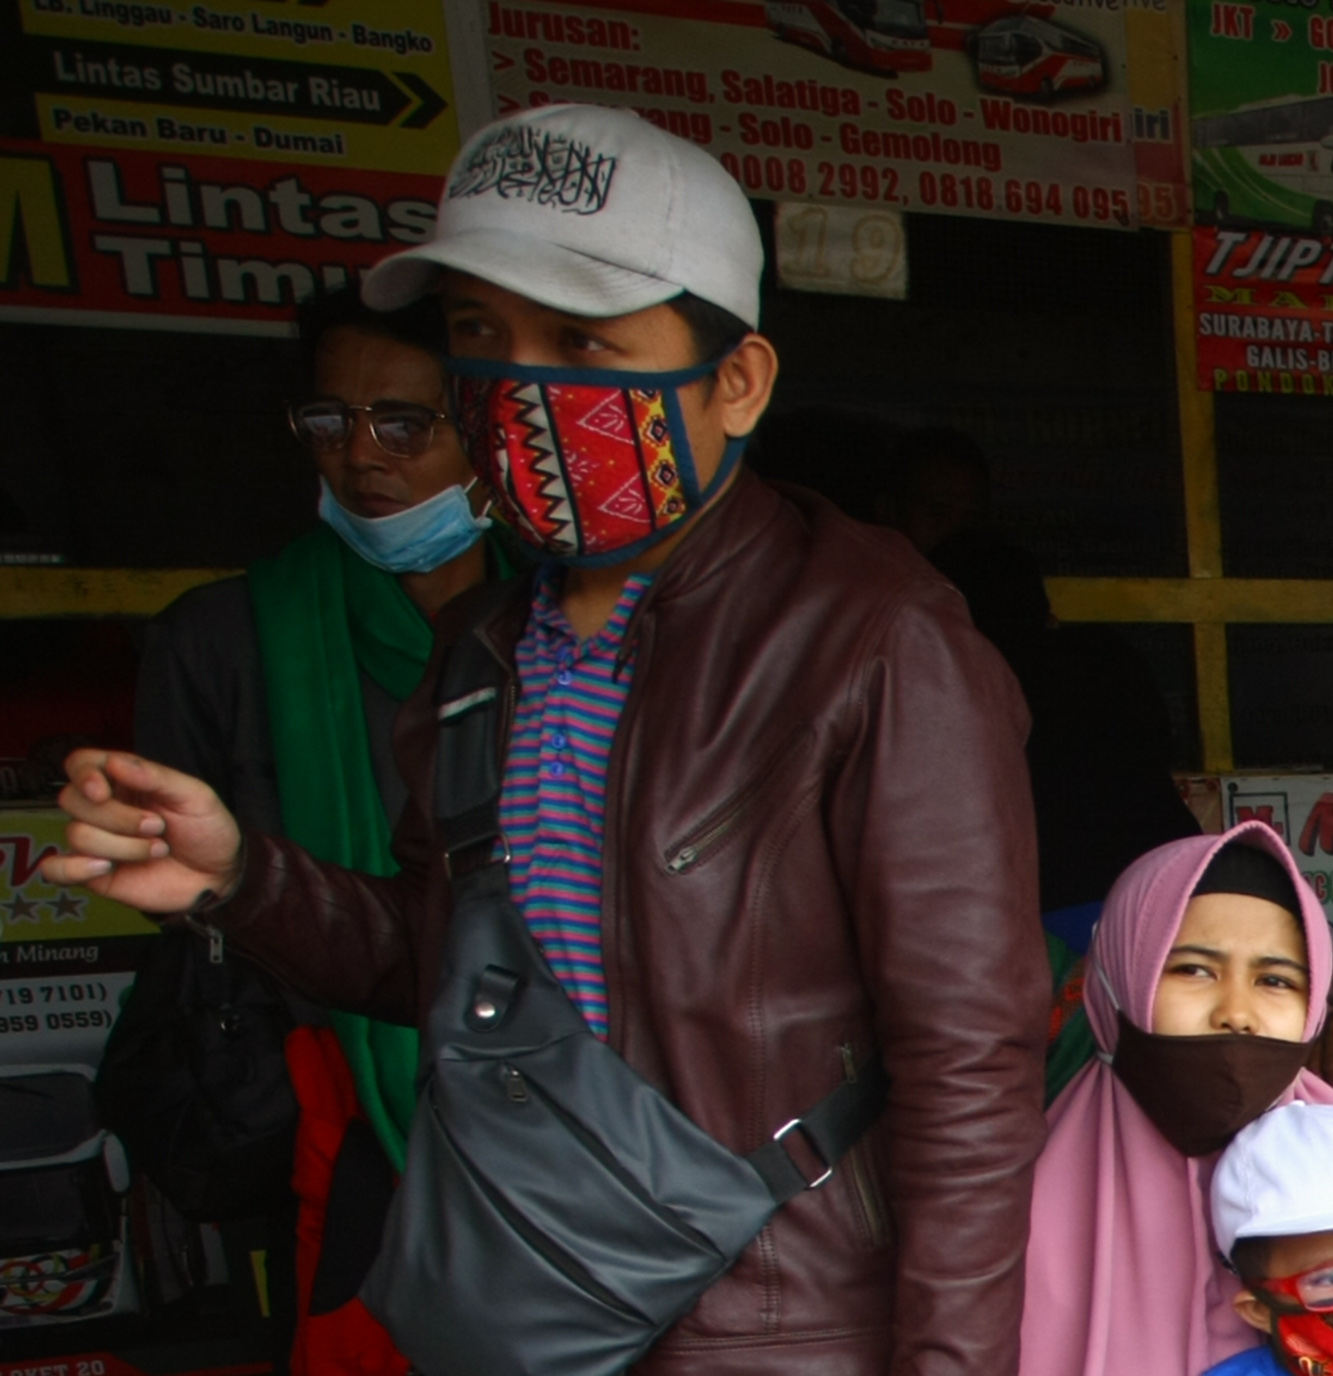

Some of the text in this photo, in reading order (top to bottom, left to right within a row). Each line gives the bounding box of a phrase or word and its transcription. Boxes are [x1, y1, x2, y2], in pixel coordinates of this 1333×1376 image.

[81, 0, 434, 54] Linggau Saro Langun Bangko
[1210, 4, 1254, 40] JKT
[53, 50, 382, 112] Lintas Sumbar Riau
[524, 49, 715, 103] Semarang,
[721, 70, 860, 117] Salatiga
[886, 89, 956, 126] Solo
[981, 98, 1121, 144] Wonogiri
[52, 108, 345, 155] Pekan Baru Dumai
[739, 113, 813, 150] Solo
[840, 123, 1001, 172] Gemolong
[86, 159, 437, 243] Lintas
[920, 172, 993, 211] 0818
[1006, 180, 1063, 217] 694
[1074, 185, 1130, 225] 095
[16, 945, 100, 963] Minang
[40, 982, 107, 1003] 7101)
[46, 1010, 113, 1030] 0559)
